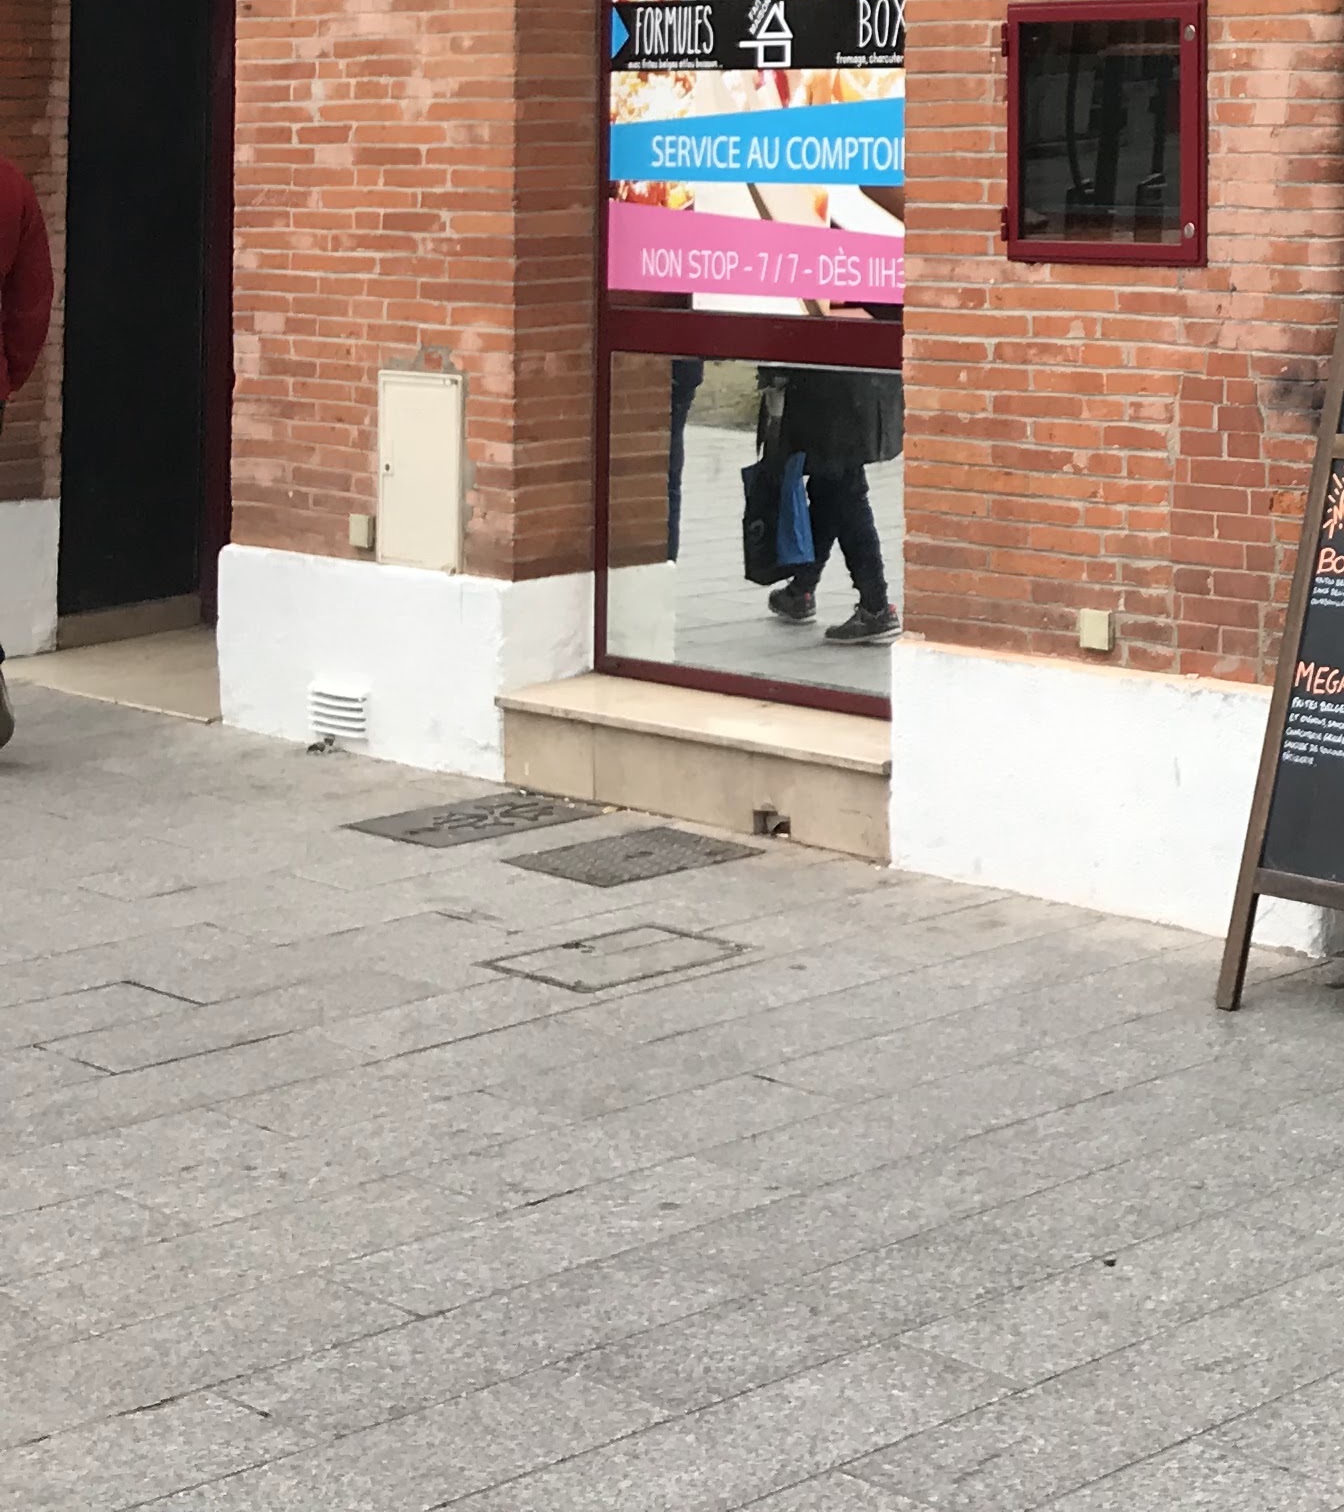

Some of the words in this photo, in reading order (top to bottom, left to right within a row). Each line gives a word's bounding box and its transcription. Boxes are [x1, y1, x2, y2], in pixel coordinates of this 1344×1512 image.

[635, 5, 714, 55] FORMULES
[651, 135, 740, 169] SERVICE
[747, 137, 780, 170] AU
[786, 136, 905, 170] COMPTOI
[642, 247, 683, 278] NON
[688, 250, 739, 281] STOP
[819, 246, 862, 287] DÈS
